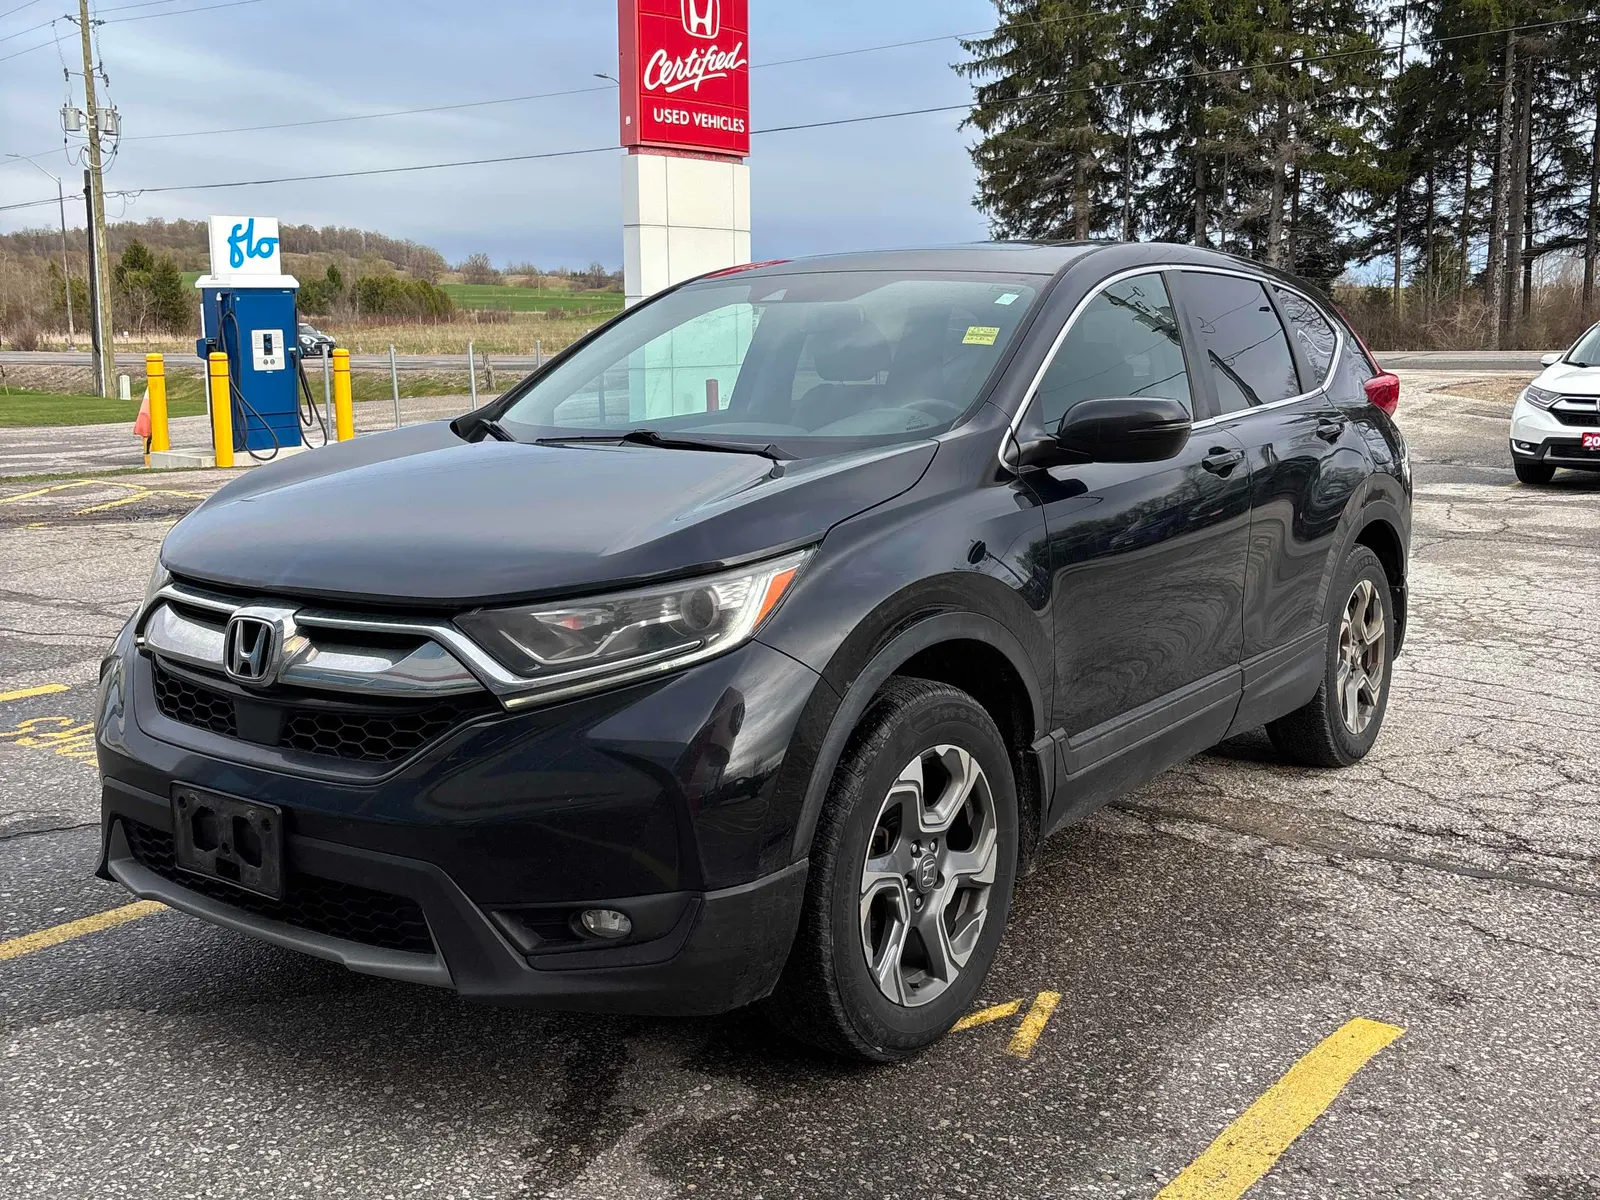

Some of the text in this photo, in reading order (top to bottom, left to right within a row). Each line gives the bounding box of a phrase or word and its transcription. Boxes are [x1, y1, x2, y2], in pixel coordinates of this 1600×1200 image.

[643, 41, 747, 93] Certified
[653, 107, 745, 133] USED VEHICLES
[227, 218, 279, 268] flo
